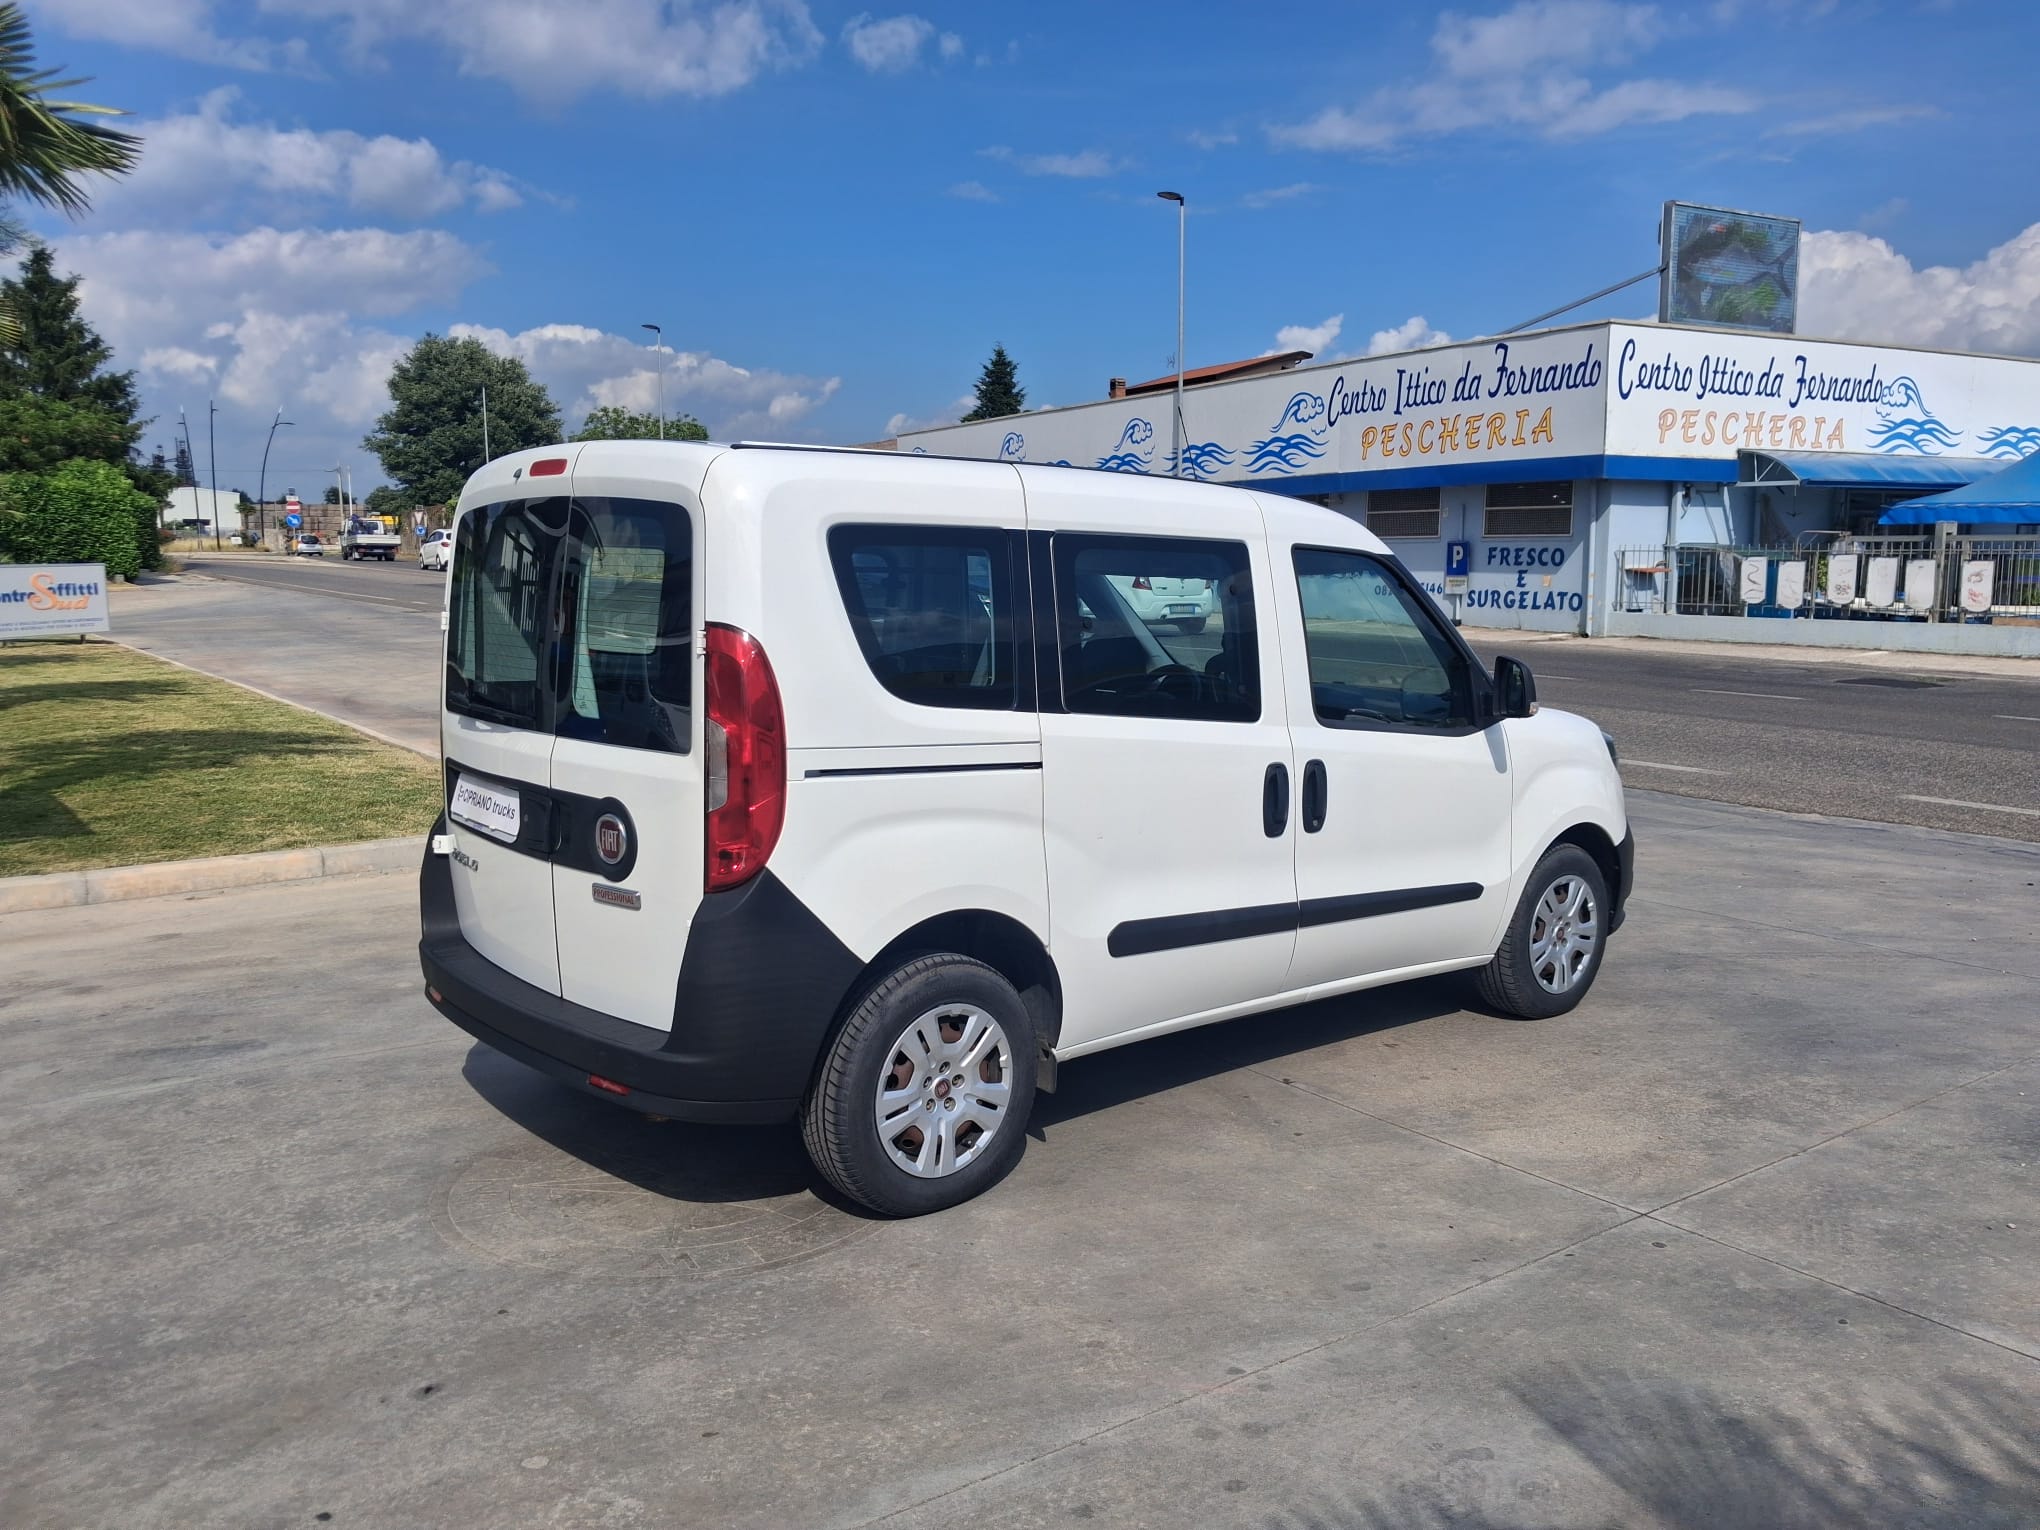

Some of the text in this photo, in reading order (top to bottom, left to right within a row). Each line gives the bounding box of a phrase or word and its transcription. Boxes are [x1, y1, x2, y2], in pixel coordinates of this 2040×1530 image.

[1327, 342, 1602, 427] Centro Ittico da Fernando
[1618, 338, 1883, 409] Centro Ittico da Fernando
[1361, 406, 1554, 461] PESCHERIA
[1658, 408, 1846, 450] PESCHERIA
[1452, 545, 1464, 569] P
[1487, 546, 1565, 567] FRESCO
[1516, 569, 1529, 588] E
[1466, 589, 1583, 612] SURGELATO
[492, 800, 516, 820] trucks
[601, 828, 619, 852] FIAT
[593, 887, 635, 905] PROFESSIONAL
